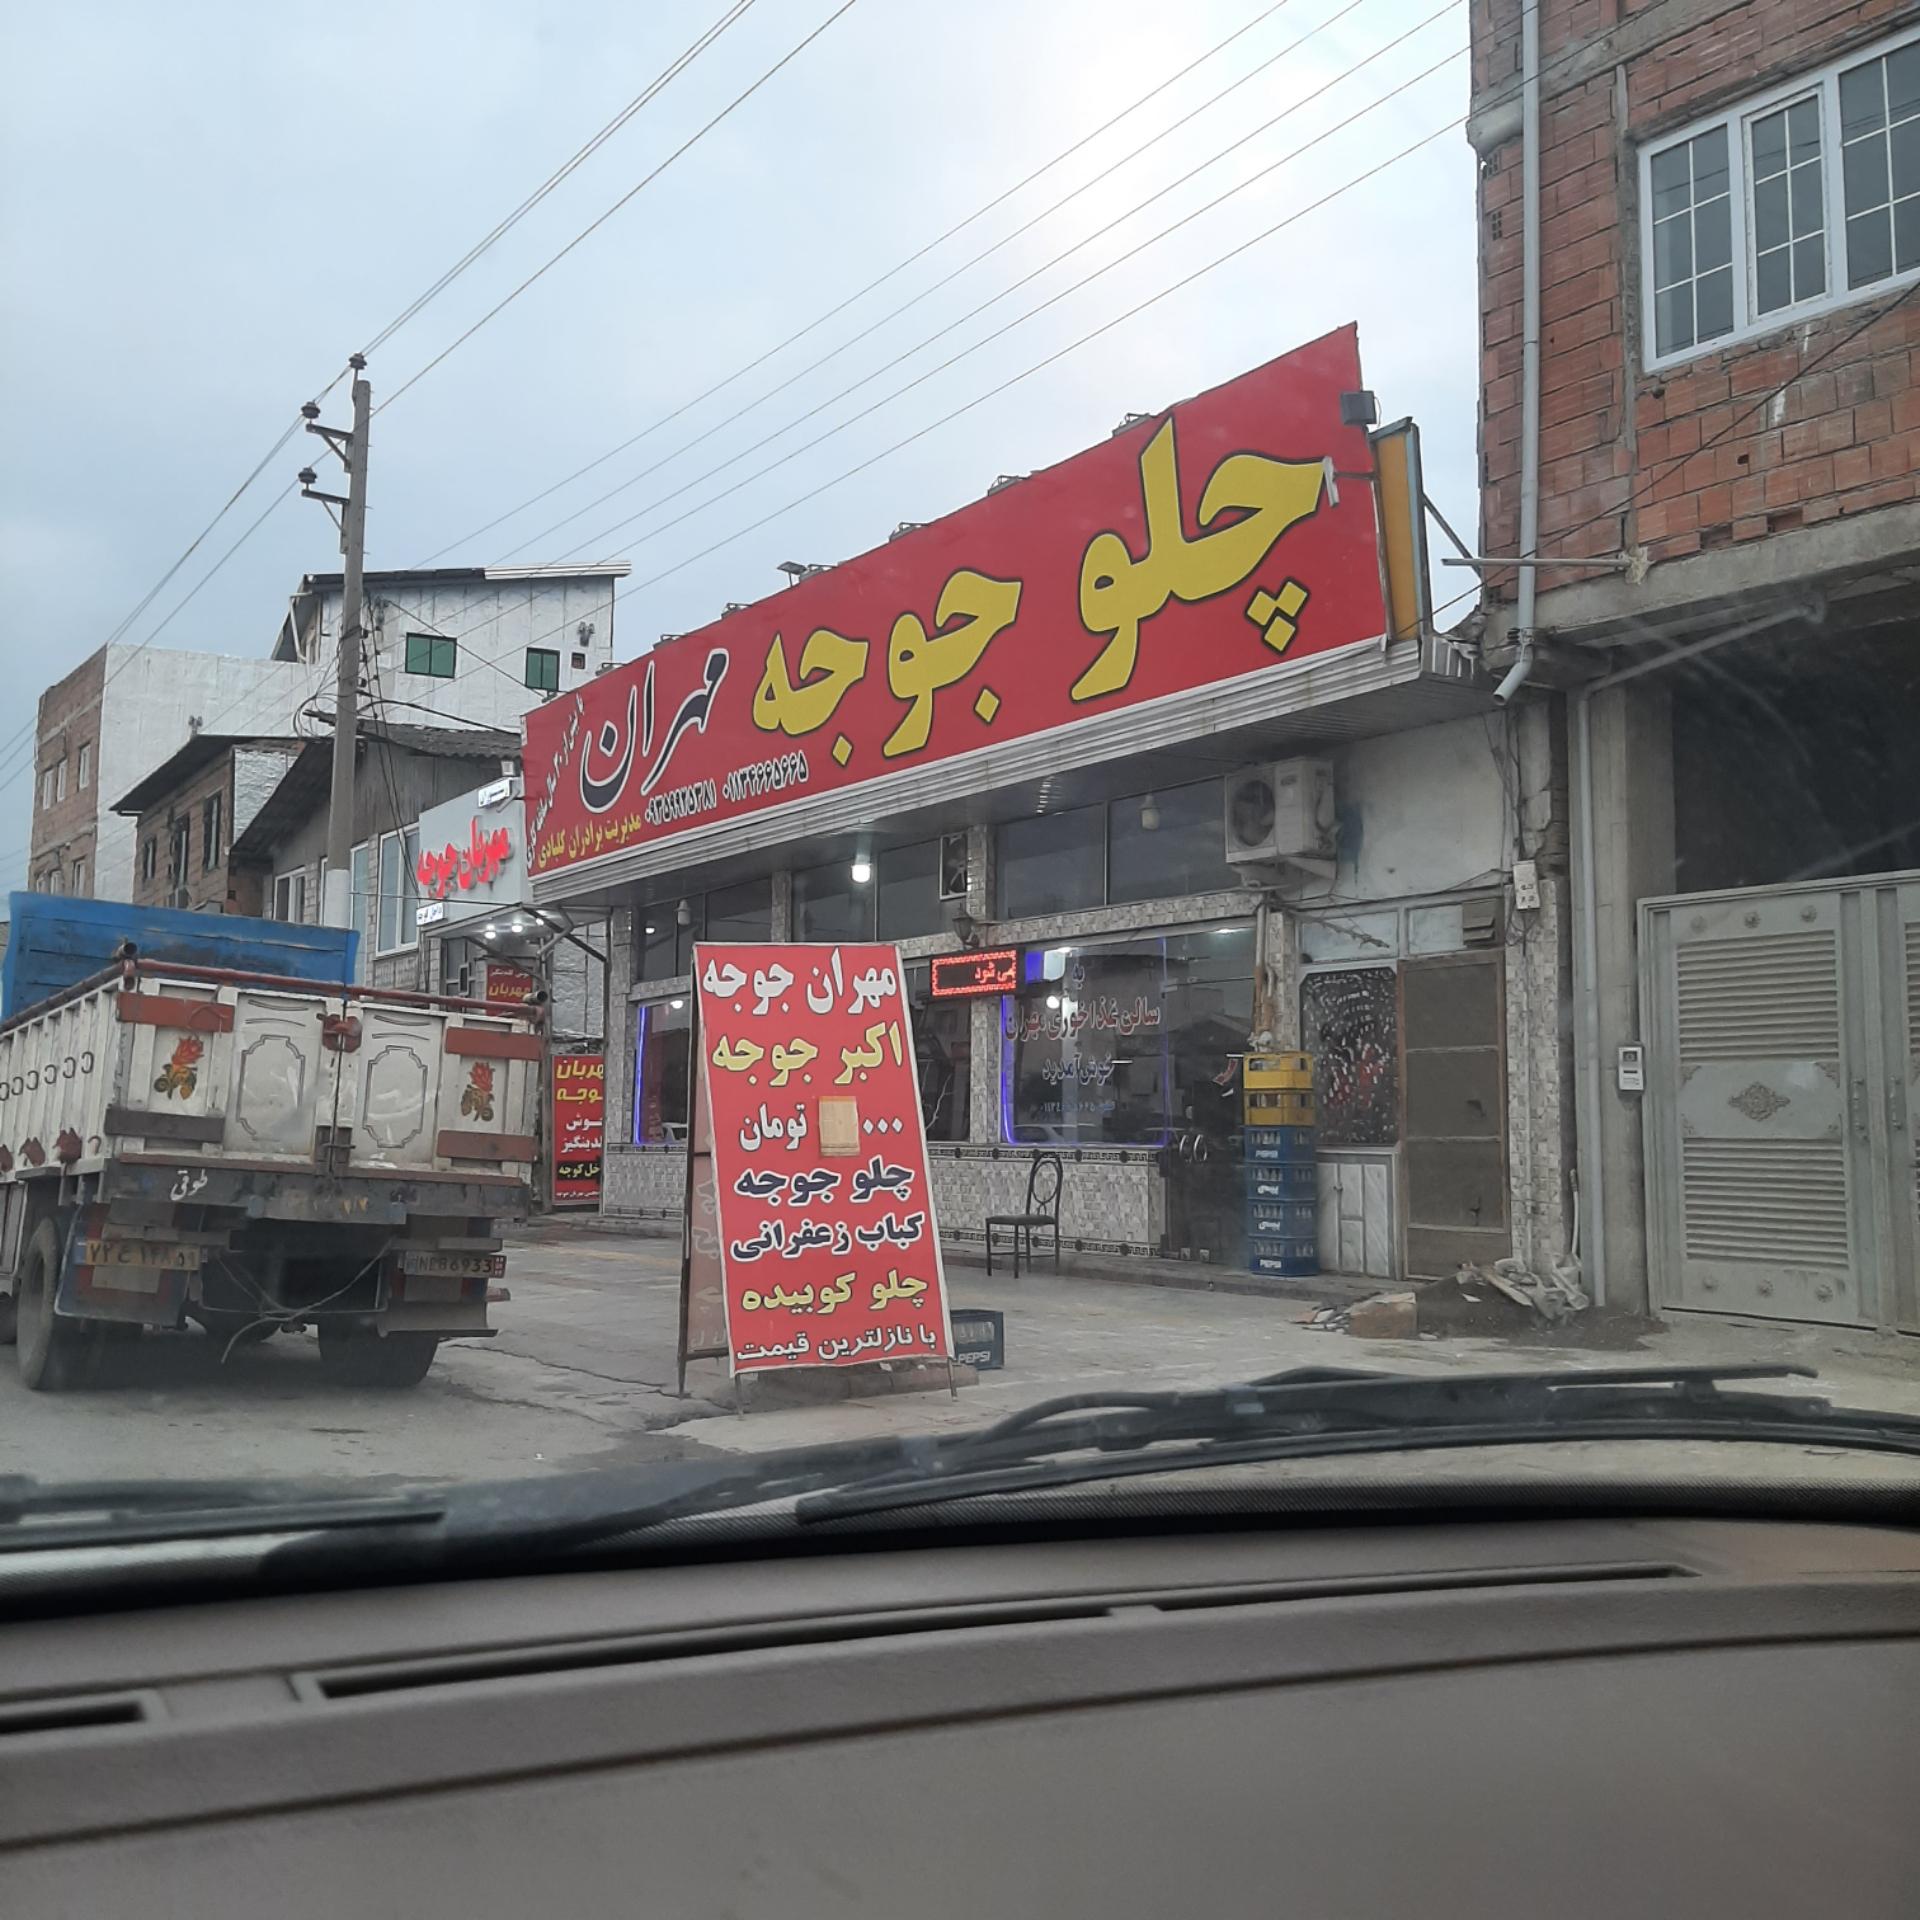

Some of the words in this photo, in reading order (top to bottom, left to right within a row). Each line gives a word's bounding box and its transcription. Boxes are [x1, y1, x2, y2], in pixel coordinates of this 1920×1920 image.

[1071, 415, 1327, 703] چلو
[751, 570, 1024, 768] جوجه
[579, 647, 731, 814] مهران
[701, 957, 795, 1016] جوجه
[805, 947, 898, 1015] مهران
[556, 1060, 604, 1080] هربان
[711, 1033, 819, 1087] جوجه
[833, 1021, 904, 1086] اکبر
[737, 1102, 808, 1154] تومان
[169, 1168, 209, 1201] طوقی
[734, 1166, 839, 1207] جوجه
[849, 1154, 916, 1203] چلو
[729, 1218, 850, 1263] زعفرانی
[855, 1211, 925, 1254] کباب
[741, 1272, 857, 1315] کوبیده
[870, 1270, 928, 1311] چلو
[735, 1331, 811, 1363] قیمت
[817, 1325, 914, 1361] نازلترین
[918, 1324, 938, 1350] با
[958, 1350, 991, 1364] PEPSI
